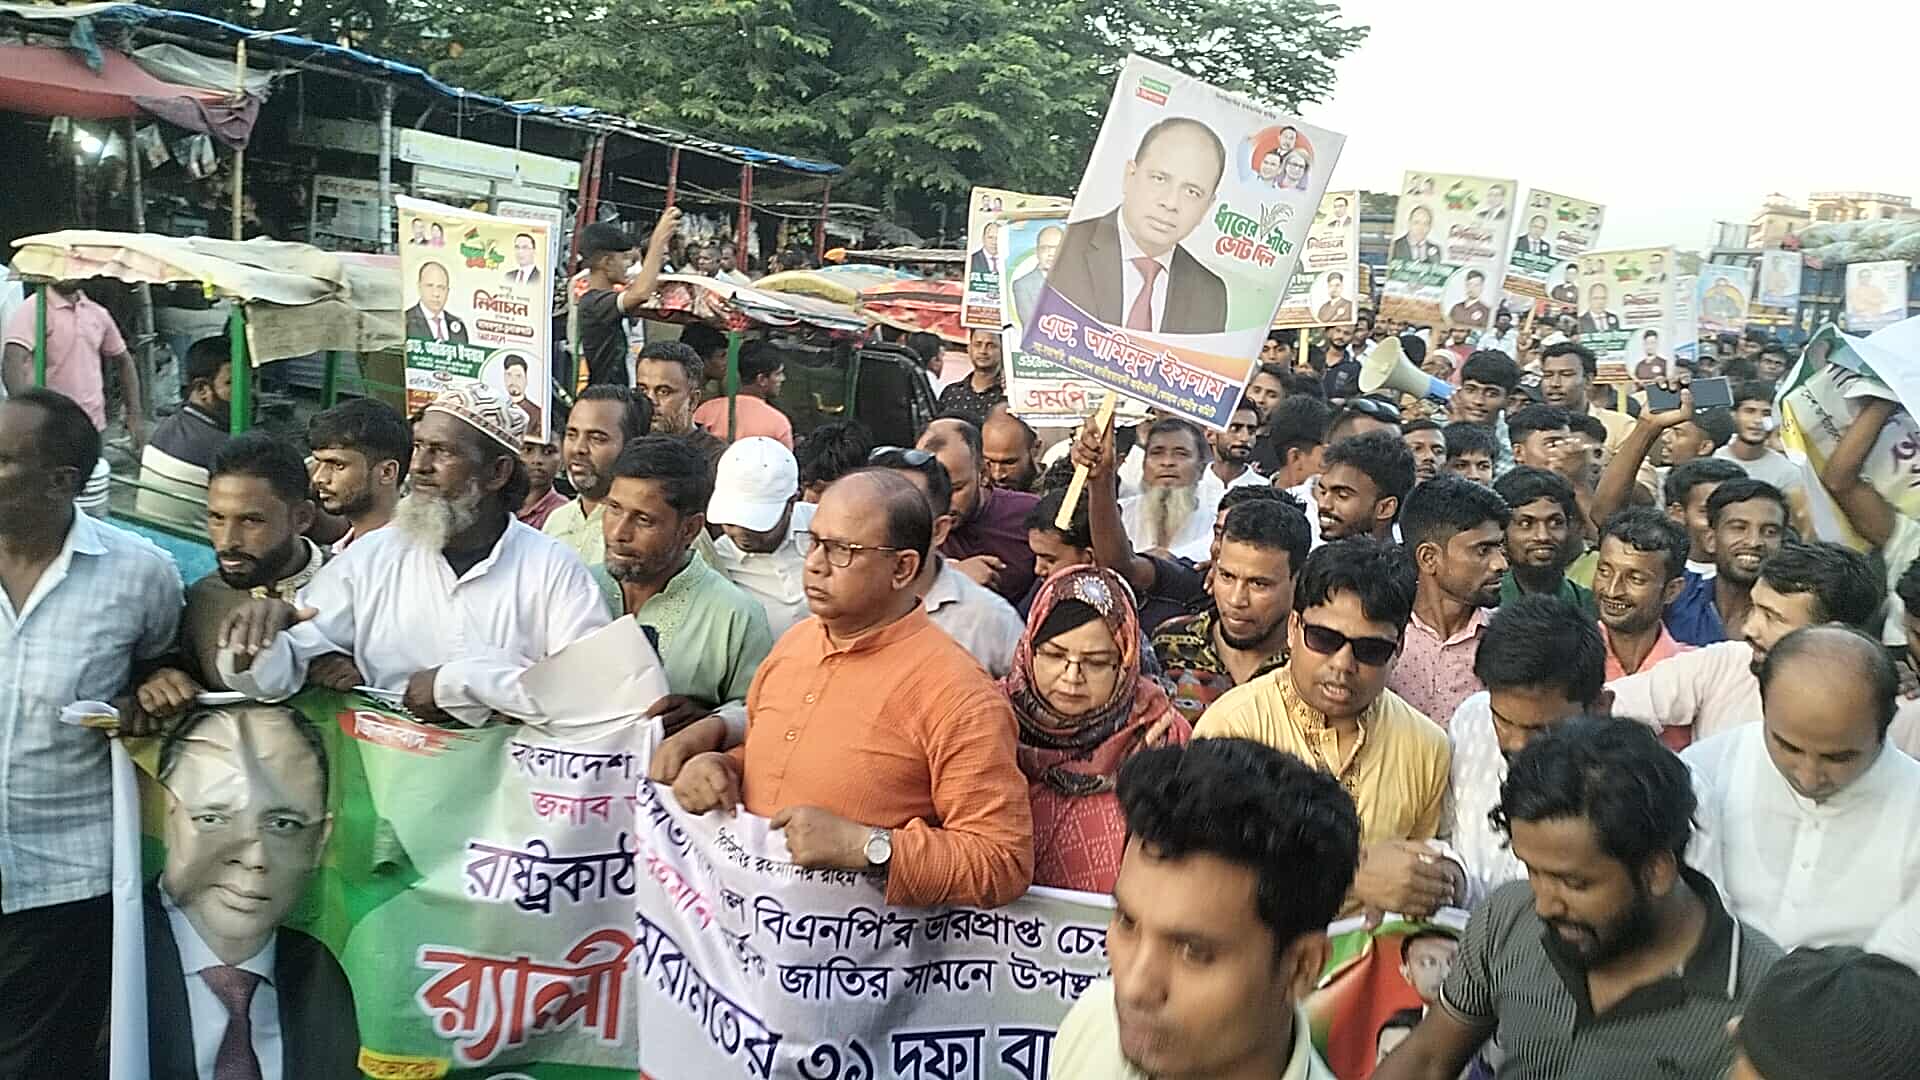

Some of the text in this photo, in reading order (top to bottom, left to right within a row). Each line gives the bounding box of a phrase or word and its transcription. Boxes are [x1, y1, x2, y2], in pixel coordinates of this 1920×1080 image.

[1215, 203, 1294, 256] ধানের শীষে
[1215, 235, 1275, 268] ভোট দিন
[473, 288, 529, 317] নির্বাচনে
[1025, 383, 1088, 410] এমপি
[1160, 350, 1230, 404] ইসলাম
[531, 791, 614, 826] জনাব
[780, 955, 894, 1000] জাতির
[903, 959, 998, 995] সামনে
[1008, 952, 1101, 1000] উপস্থ
[925, 910, 1046, 949] ভারপ্রাপ্ত
[467, 831, 637, 914] রাষ্ট্রকাঠ
[797, 1039, 875, 1080] ৩১
[892, 1028, 987, 1080] দফা
[998, 1027, 1059, 1080] বা
